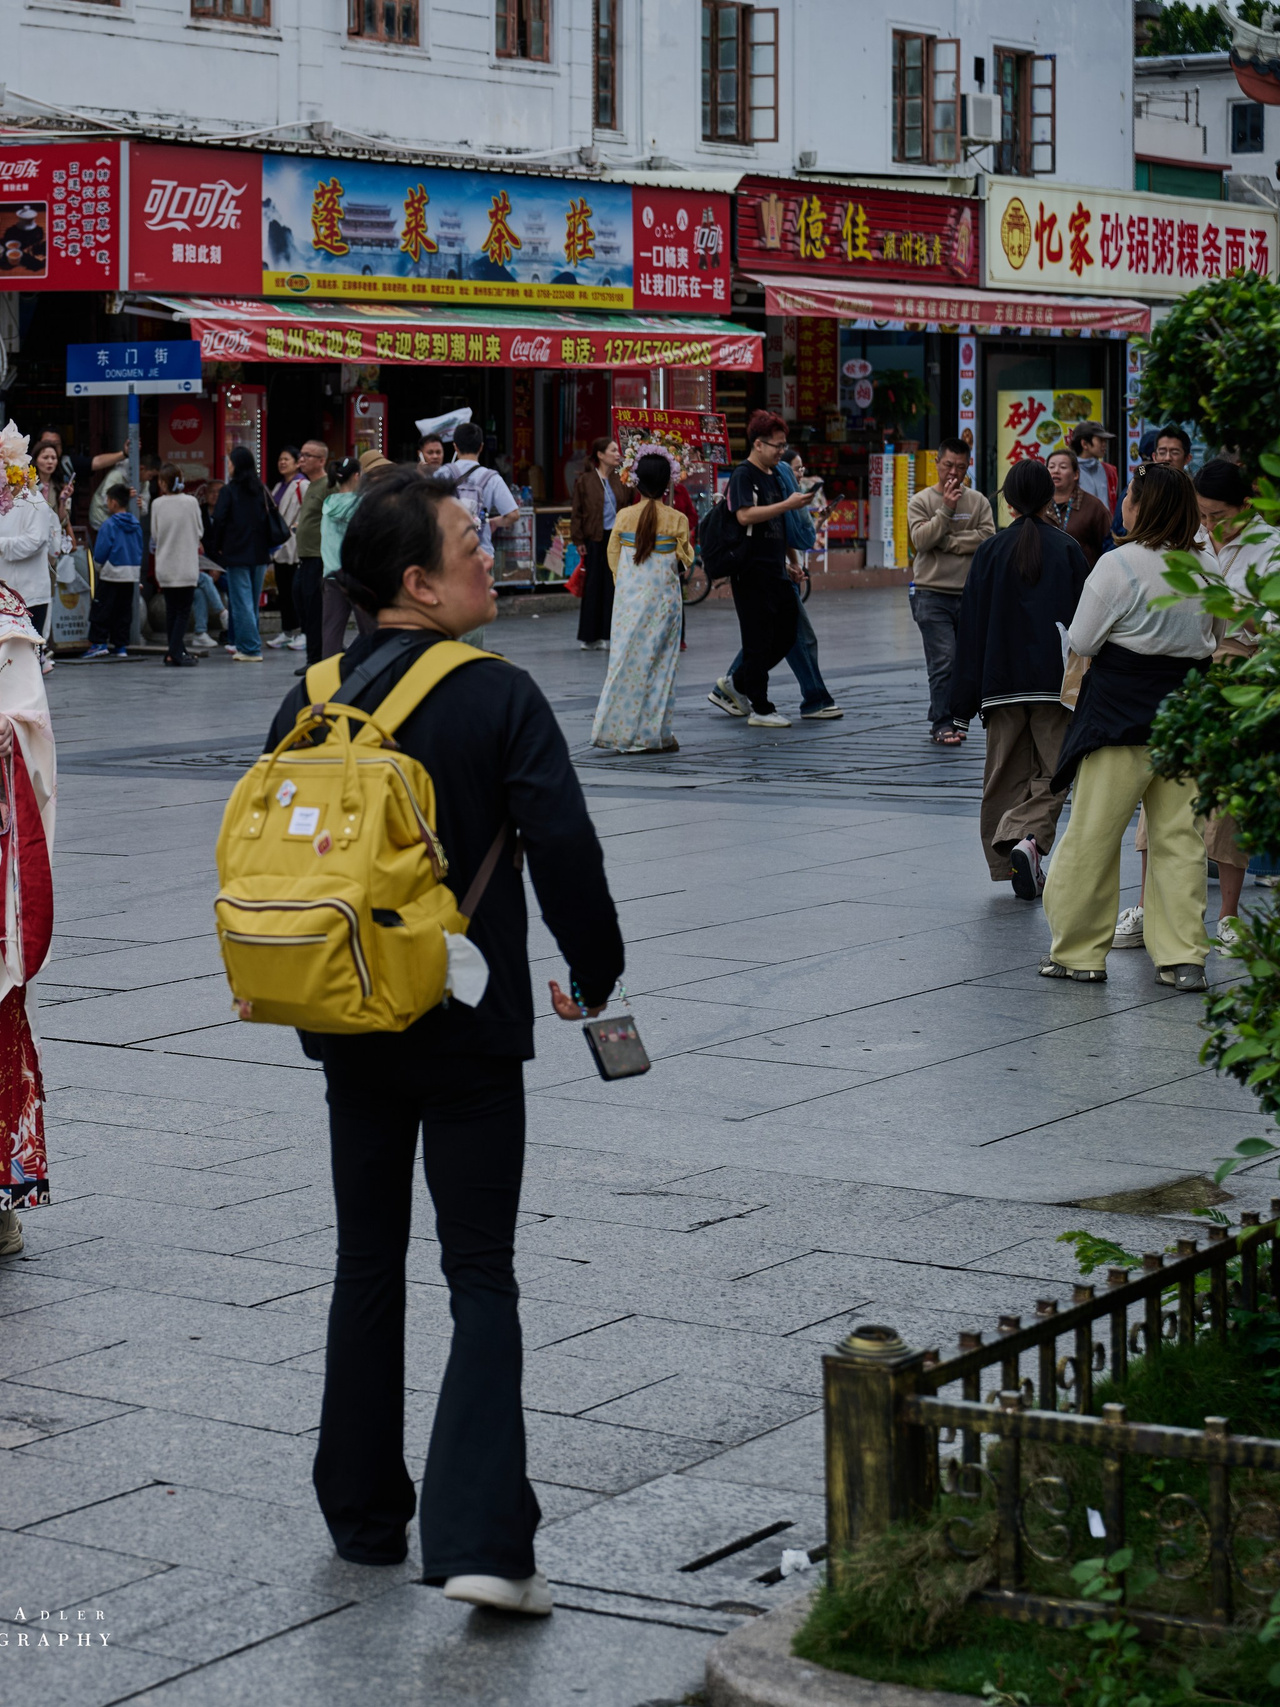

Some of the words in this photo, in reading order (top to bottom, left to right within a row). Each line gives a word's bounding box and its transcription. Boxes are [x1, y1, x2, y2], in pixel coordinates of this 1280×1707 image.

[143, 179, 248, 232] 可口可乐
[1034, 200, 1094, 277] 忆家
[1100, 212, 1269, 279] 砂锅粥粿条面汤
[640, 245, 689, 269] 一口畅爽
[640, 273, 726, 300] 让我们乐在一起
[894, 298, 980, 320] 消费者信得过单位
[97, 347, 168, 366] 东门街
[201, 328, 254, 356] 可口可乐
[266, 327, 363, 359] 潮州欢迎您
[376, 330, 501, 363] 欢迎您到潮州来
[604, 339, 712, 366] 13715795188
[105, 368, 144, 378] DONGMEN
[148, 368, 159, 377] JIE
